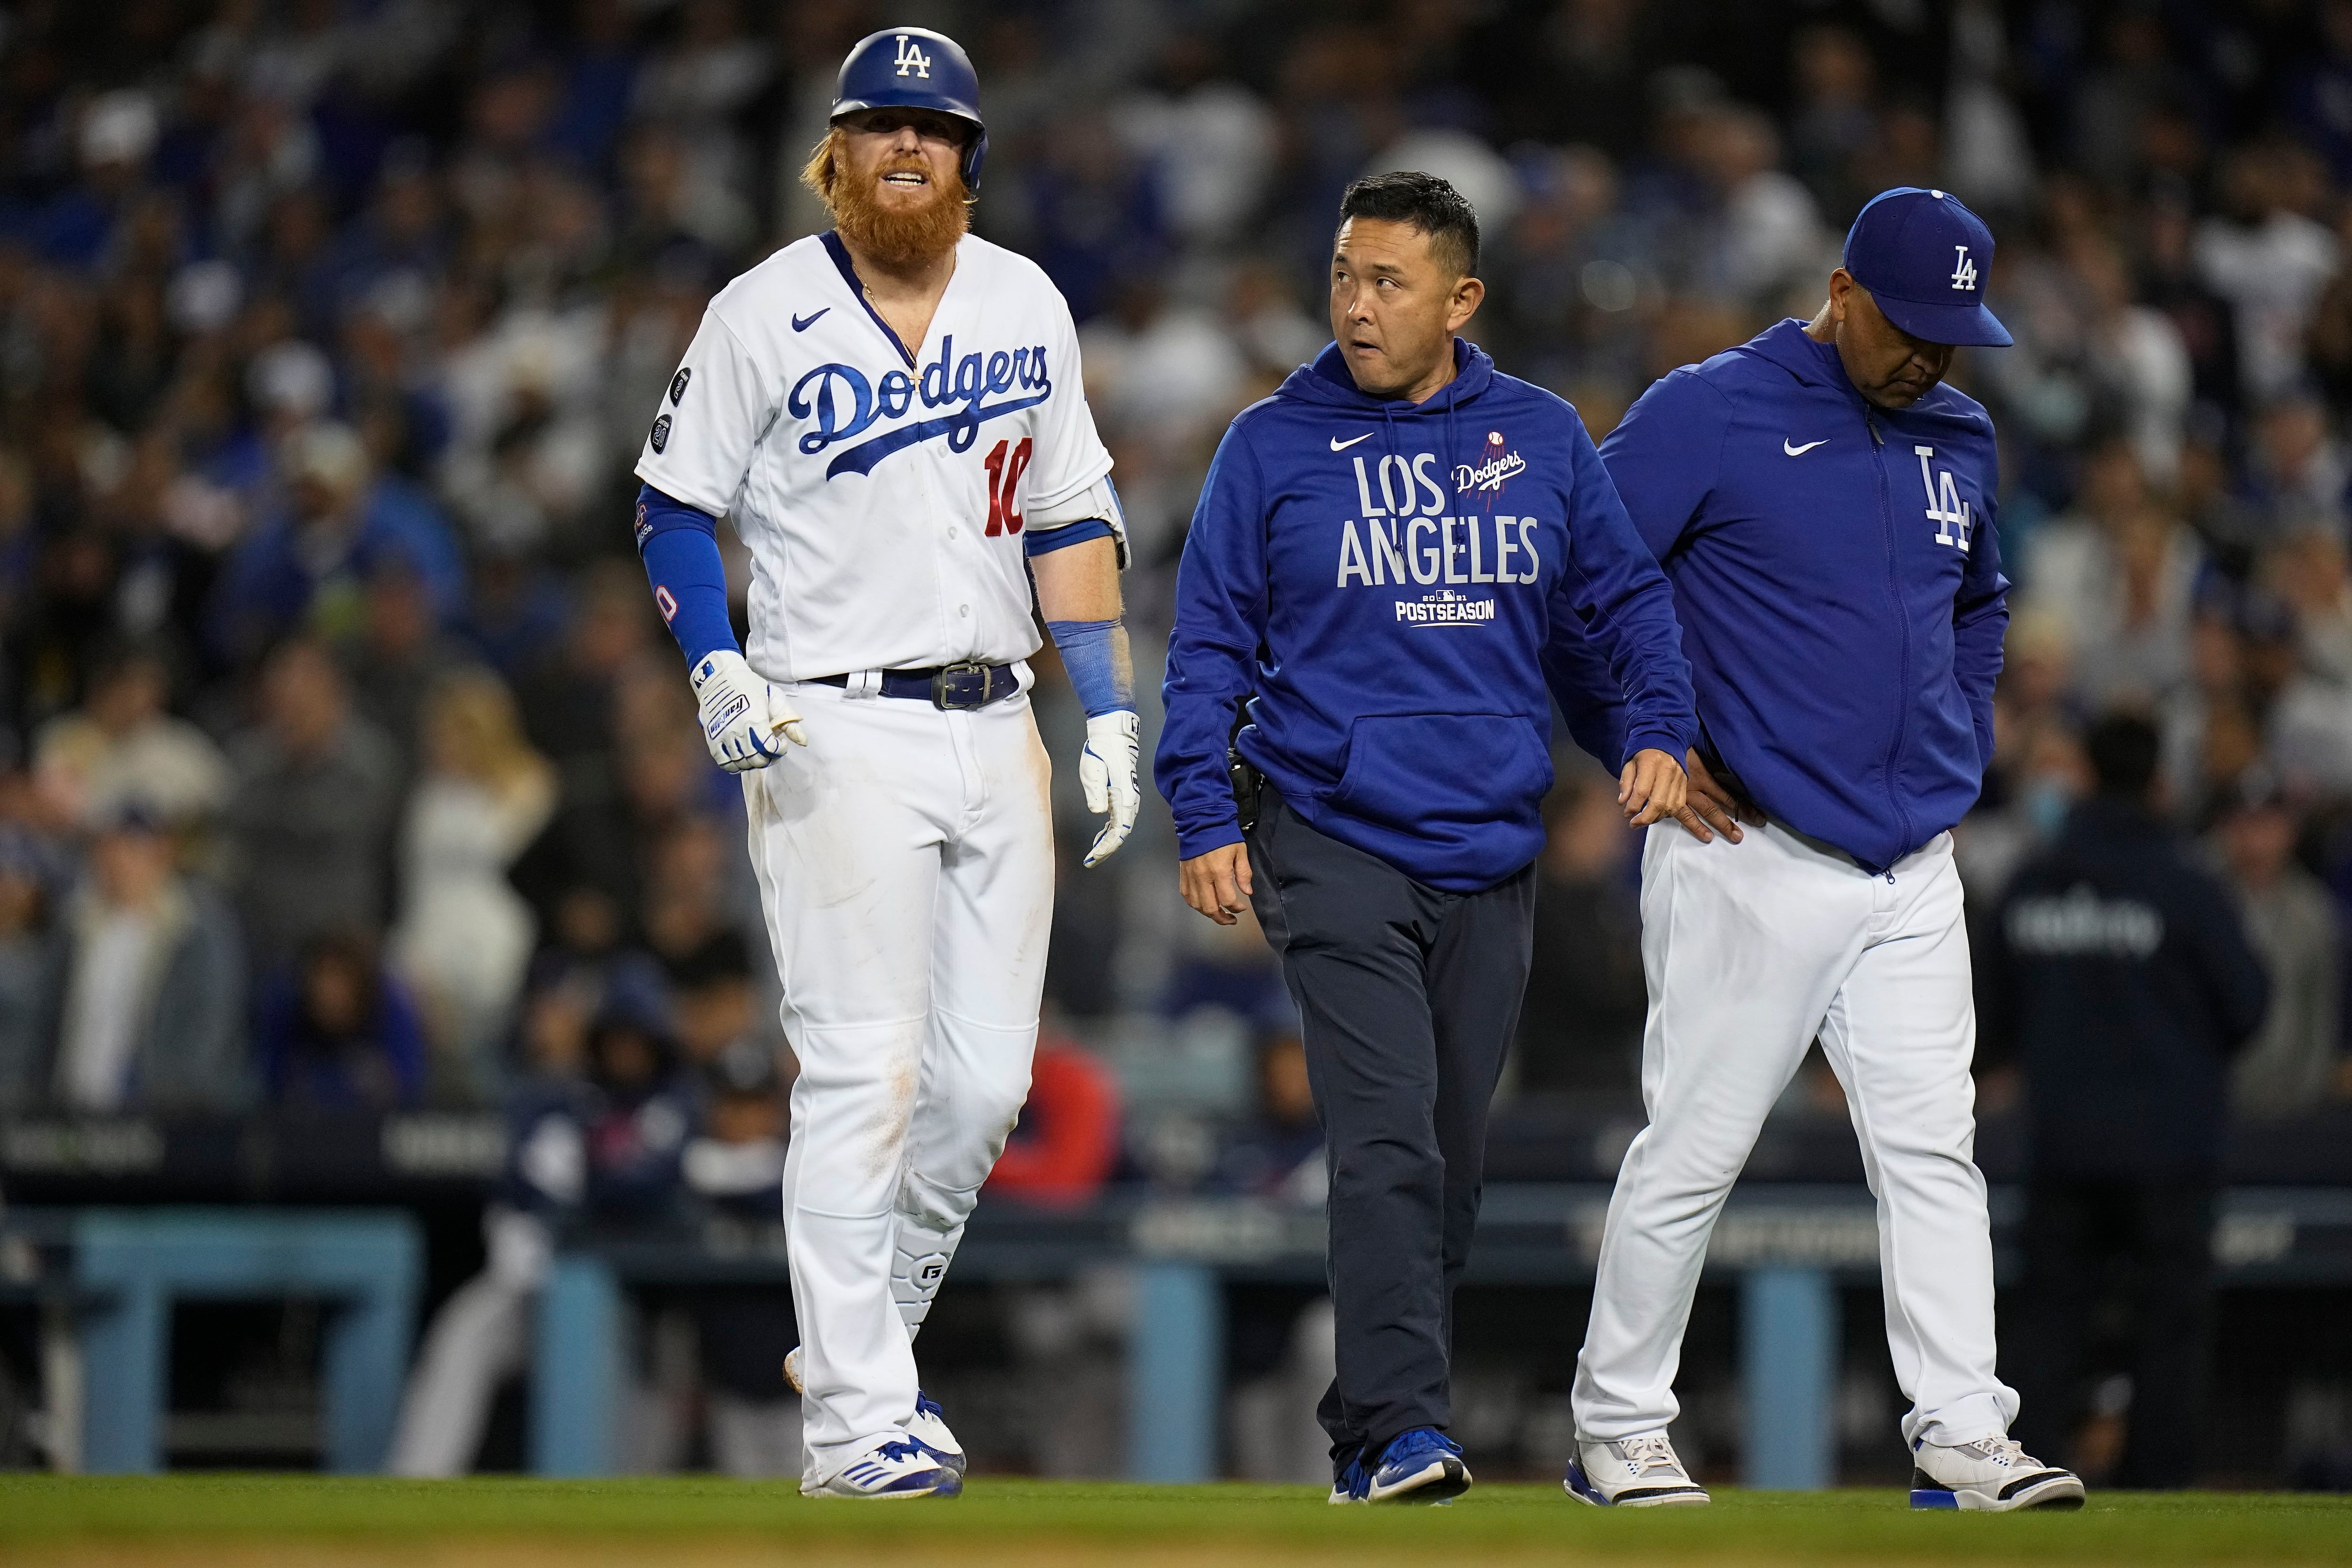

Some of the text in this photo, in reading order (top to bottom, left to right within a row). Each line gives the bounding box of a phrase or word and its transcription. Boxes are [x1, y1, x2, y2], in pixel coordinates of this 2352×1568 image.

[894, 35, 930, 78] LA
[1951, 245, 1977, 290] LA
[674, 379, 683, 399] 2
[788, 334, 1051, 454] Dodgers
[653, 425, 666, 447] 20
[658, 418, 670, 429] SUTTON
[984, 438, 1032, 536] 10
[1353, 453, 1445, 517] LOS
[1451, 450, 1526, 493] Dodgers
[1915, 446, 1971, 552] LA
[1337, 516, 1540, 588] ANGELES
[1395, 599, 1494, 621] POSTSEASON
